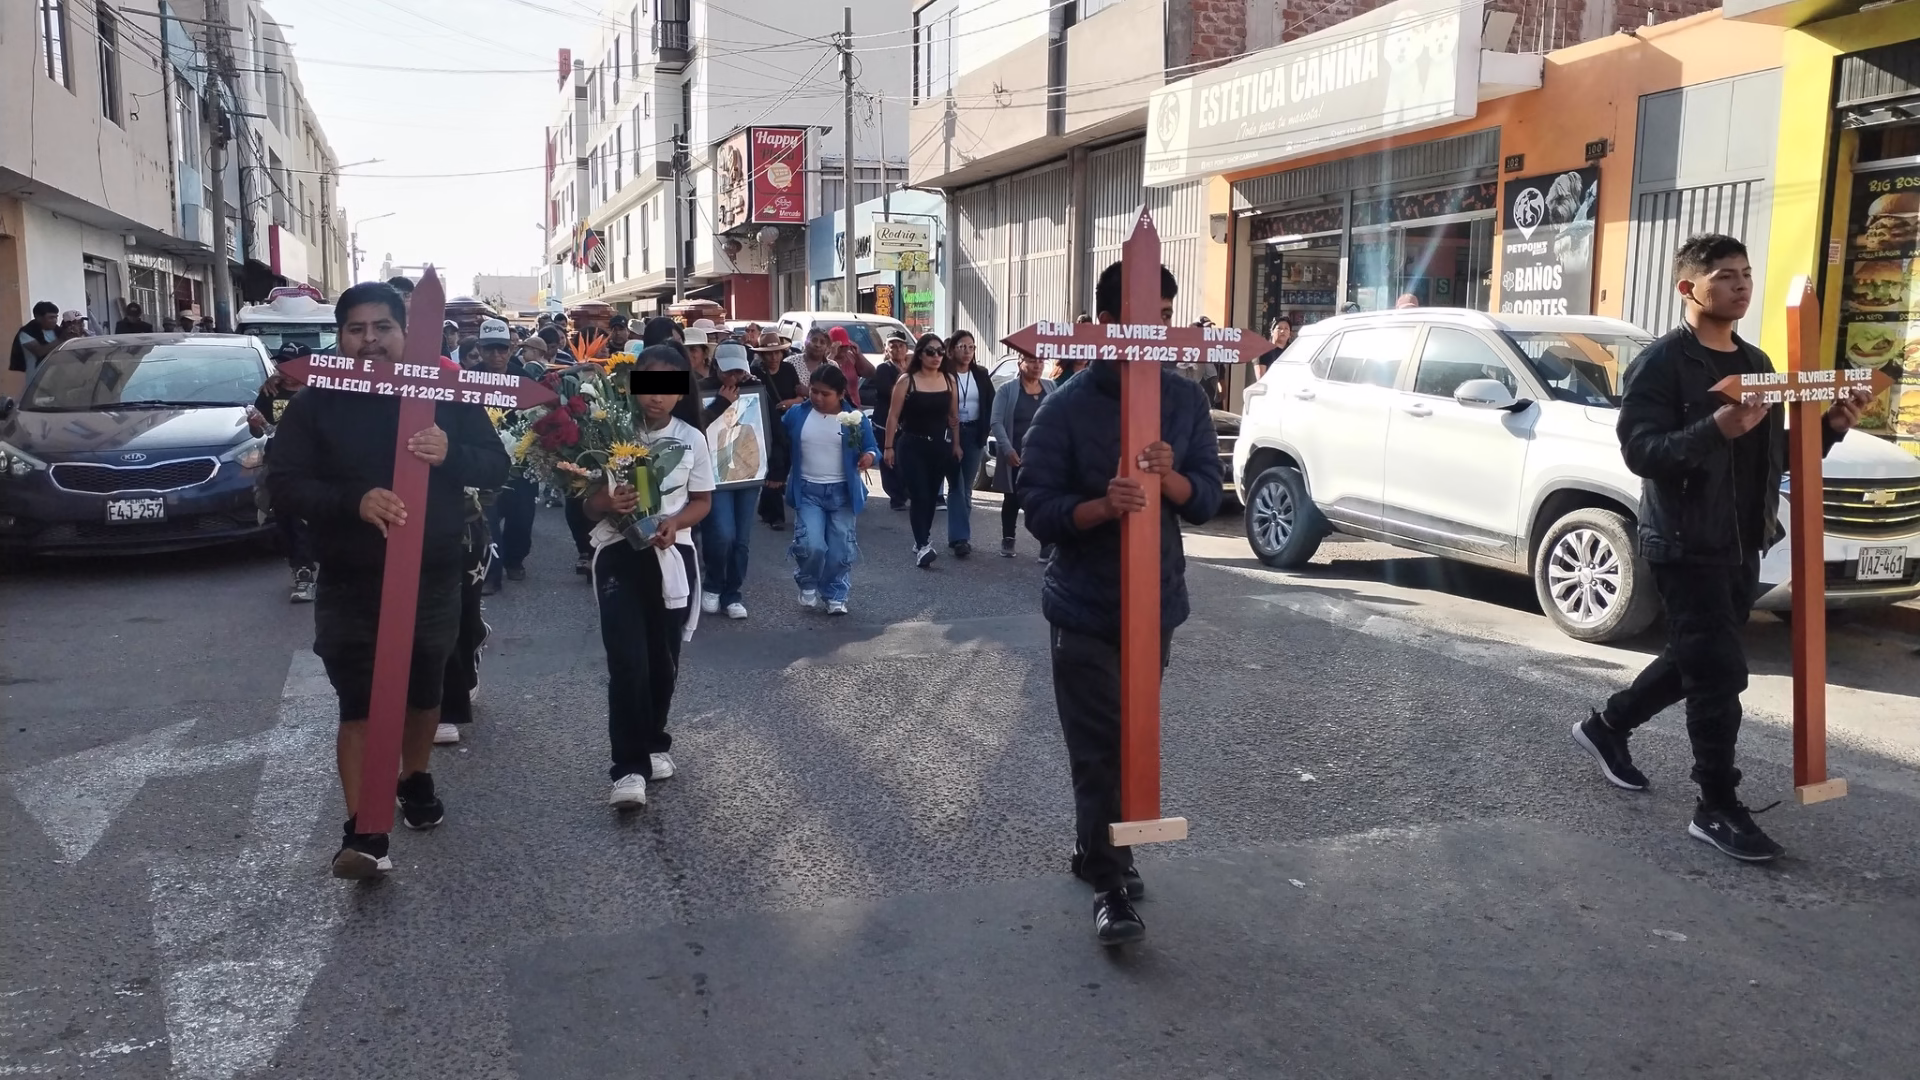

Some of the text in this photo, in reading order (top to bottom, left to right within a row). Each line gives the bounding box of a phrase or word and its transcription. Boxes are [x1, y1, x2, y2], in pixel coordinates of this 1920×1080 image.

[1199, 31, 1379, 129] ESTÉTICA CANINA
[1257, 117, 1276, 138] para
[1278, 115, 1287, 128] tu
[755, 131, 799, 149] Happy
[1587, 143, 1602, 155] 100
[1506, 157, 1519, 168] 102
[1868, 179, 1892, 192] BIG
[1506, 241, 1548, 254] PETPOINT
[1514, 262, 1563, 292] BAÑOS
[1513, 297, 1568, 315] CORTES
[1036, 321, 1242, 342] ALAN ALVAREZ RIVAS
[1035, 342, 1097, 359] FALLECIO
[1182, 347, 1201, 362] 39
[1207, 345, 1241, 364] AÑOS
[309, 353, 520, 387] OSCAR E. PEREZ CAHUANA
[1741, 368, 1873, 386] GUILLERMO ALVAREZ PEREZ
[306, 374, 371, 393] FALLECIO
[461, 390, 481, 404] 33
[483, 390, 518, 408] AÑOS
[1838, 386, 1850, 399] 63
[1875, 548, 1893, 556] PERU
[1861, 554, 1903, 575] VAZ-461
